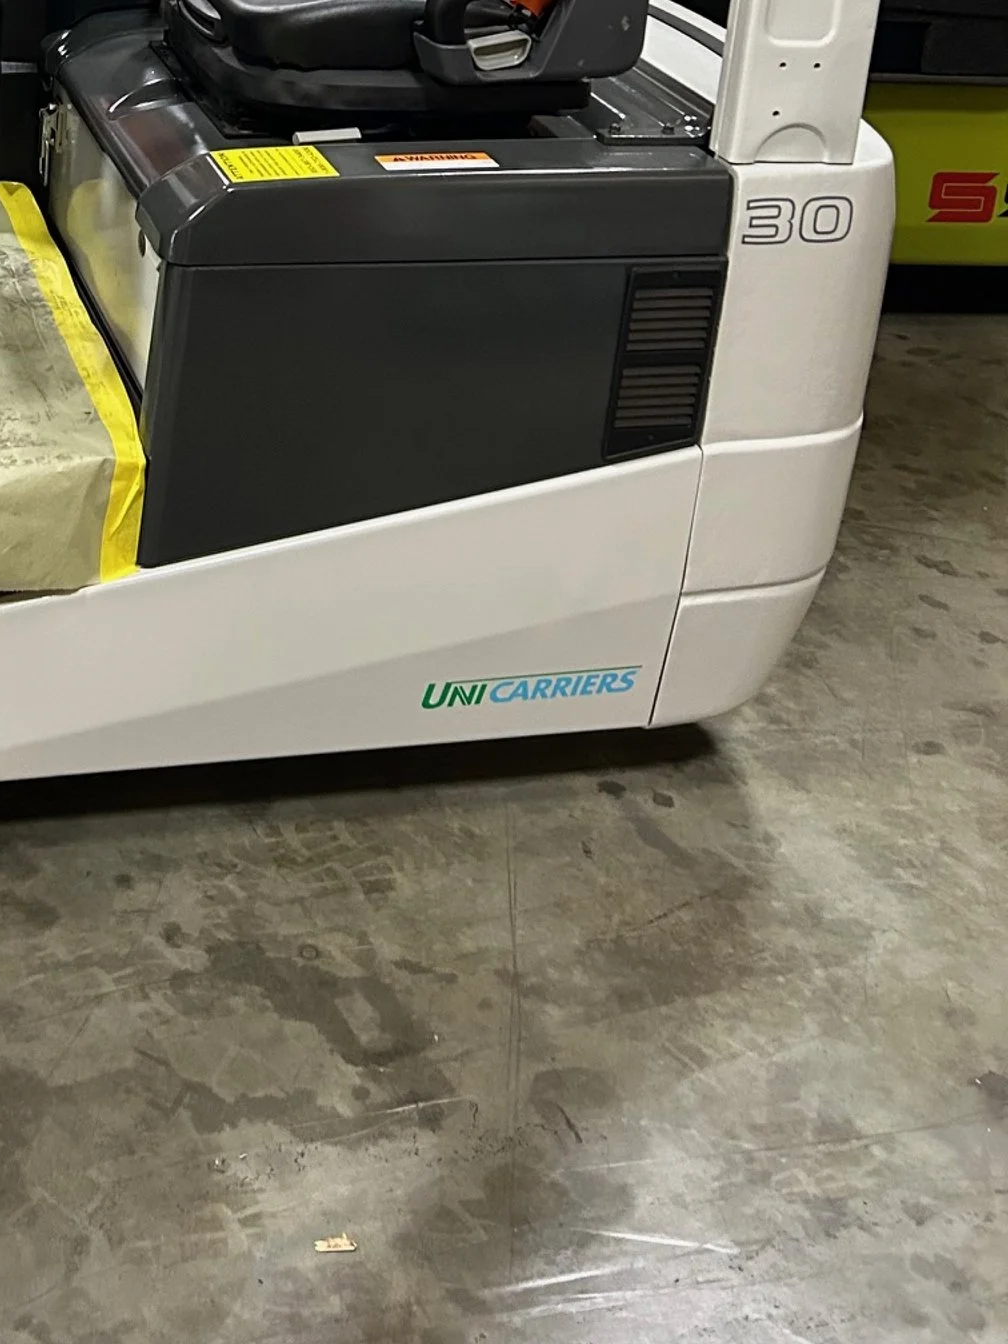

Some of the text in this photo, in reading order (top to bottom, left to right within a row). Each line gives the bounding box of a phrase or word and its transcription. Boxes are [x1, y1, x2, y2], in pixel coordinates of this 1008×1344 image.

[741, 195, 854, 245] 30
[926, 171, 1008, 223] S
[421, 665, 642, 710] UNICARRIERS
